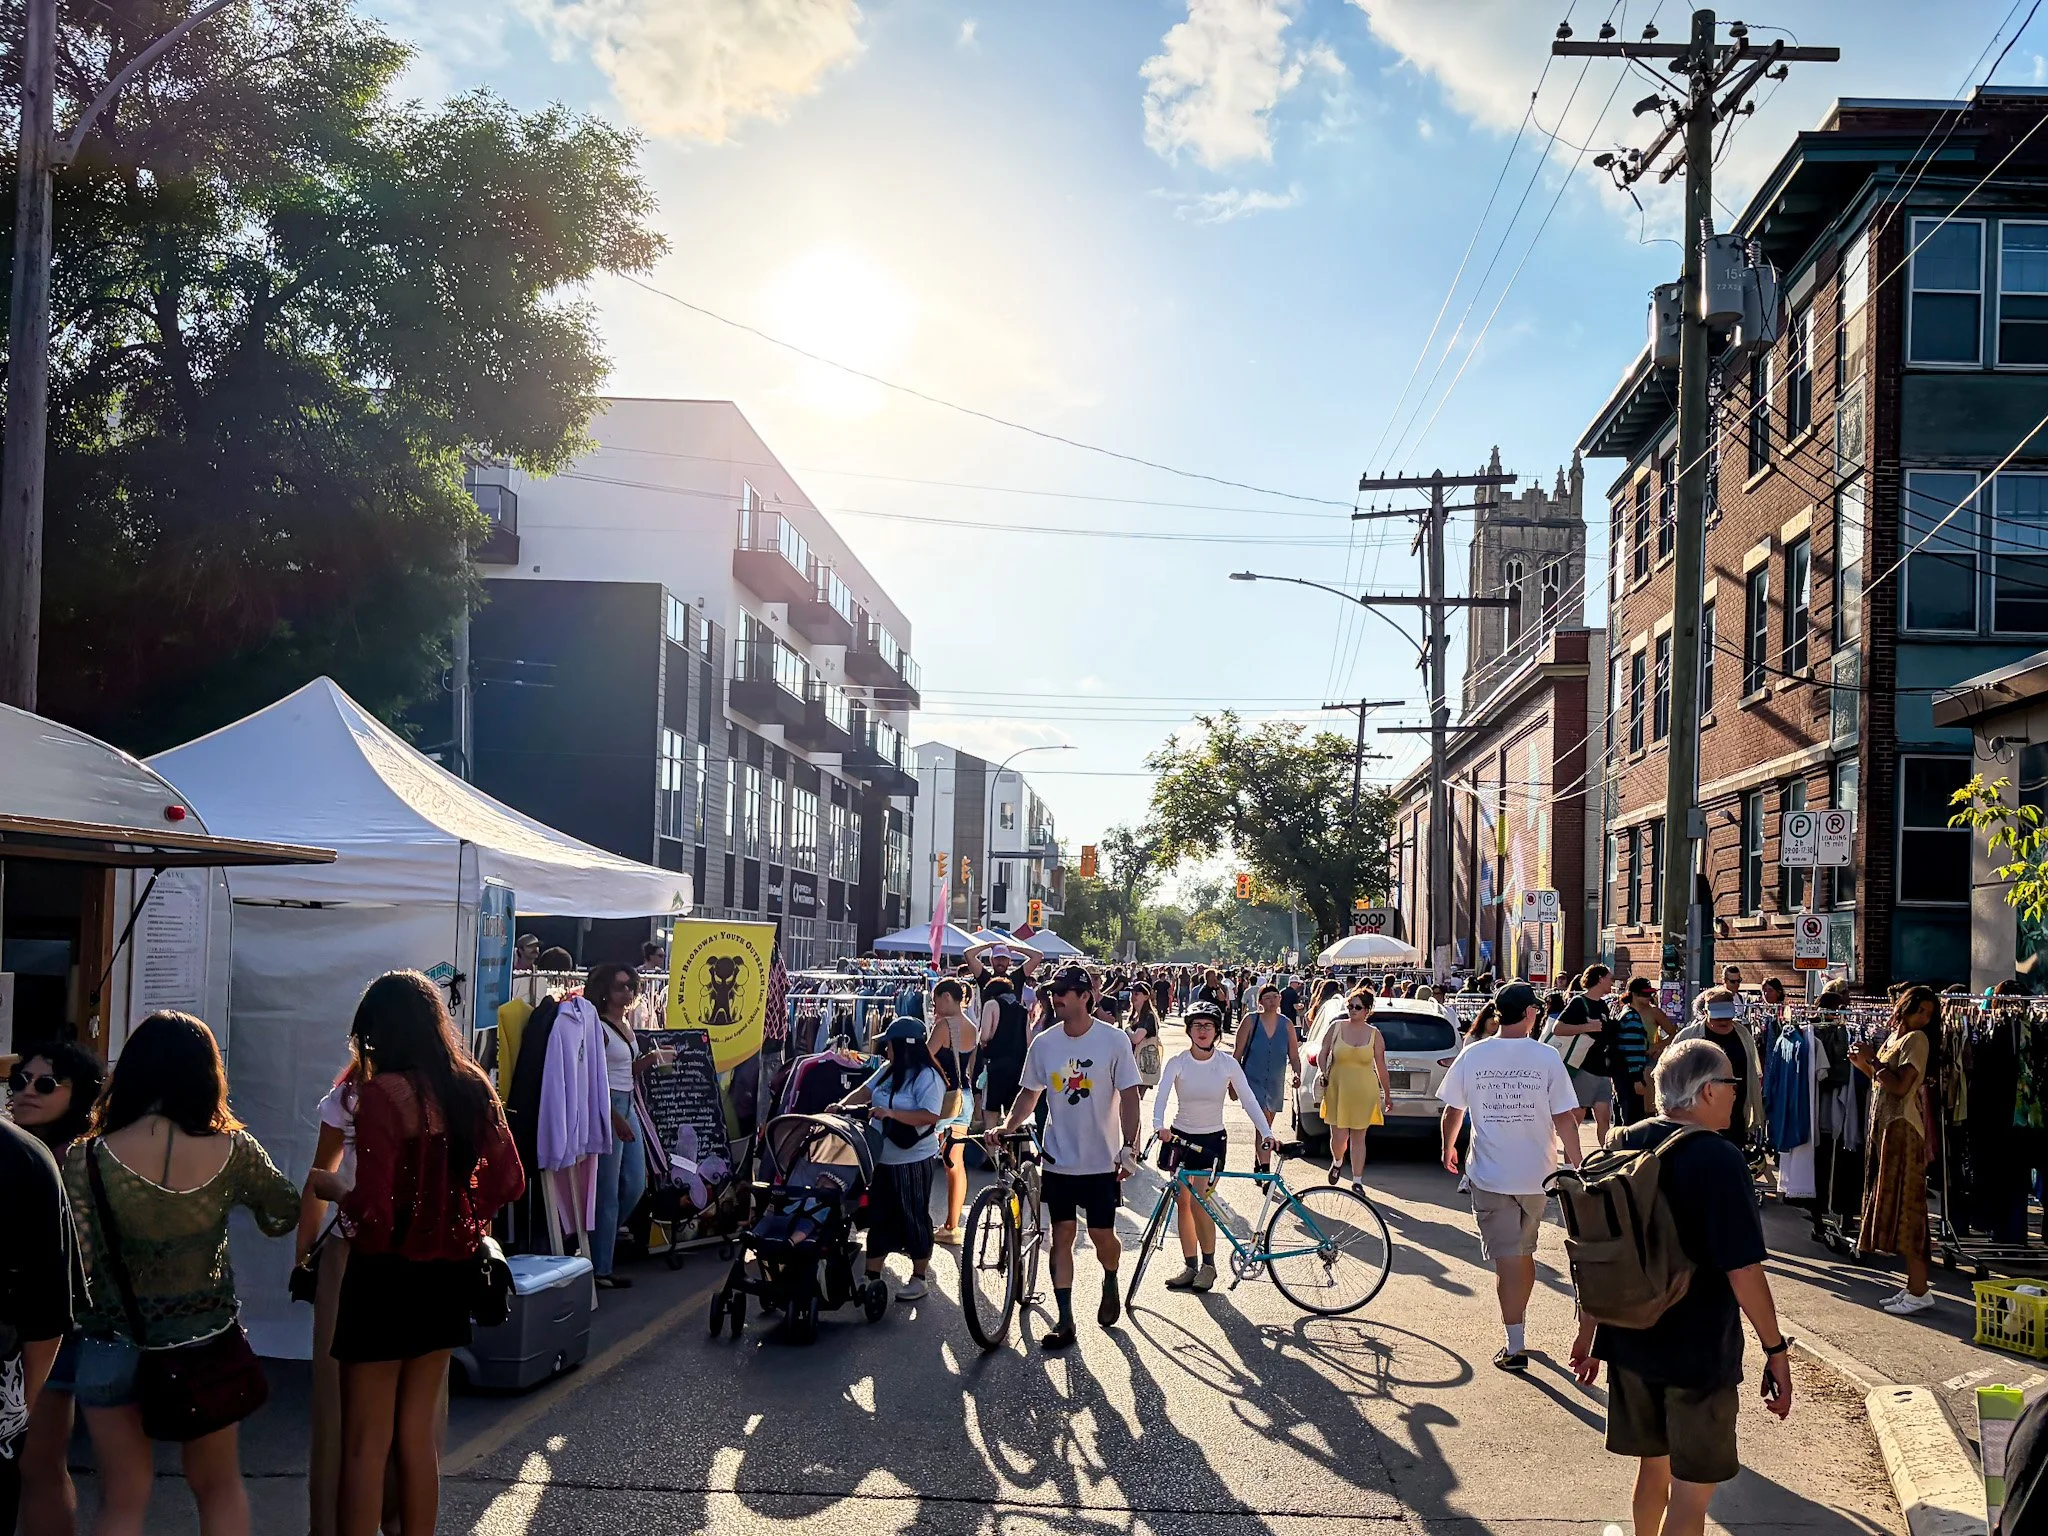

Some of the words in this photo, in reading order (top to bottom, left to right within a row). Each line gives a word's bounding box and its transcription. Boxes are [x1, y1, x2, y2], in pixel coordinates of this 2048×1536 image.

[1725, 268, 1738, 279] 15
[1353, 913, 1386, 926] FOOD
[720, 931, 746, 945] YOUTH
[745, 941, 766, 986] OUTREACH
[1475, 1070, 1542, 1078] WINNIPEG'S
[1502, 1082, 1517, 1090] The
[1518, 1082, 1541, 1091] People
[1495, 1092, 1503, 1100] In
[1505, 1092, 1522, 1100] Your
[1482, 1102, 1535, 1111] Neighbourhood
